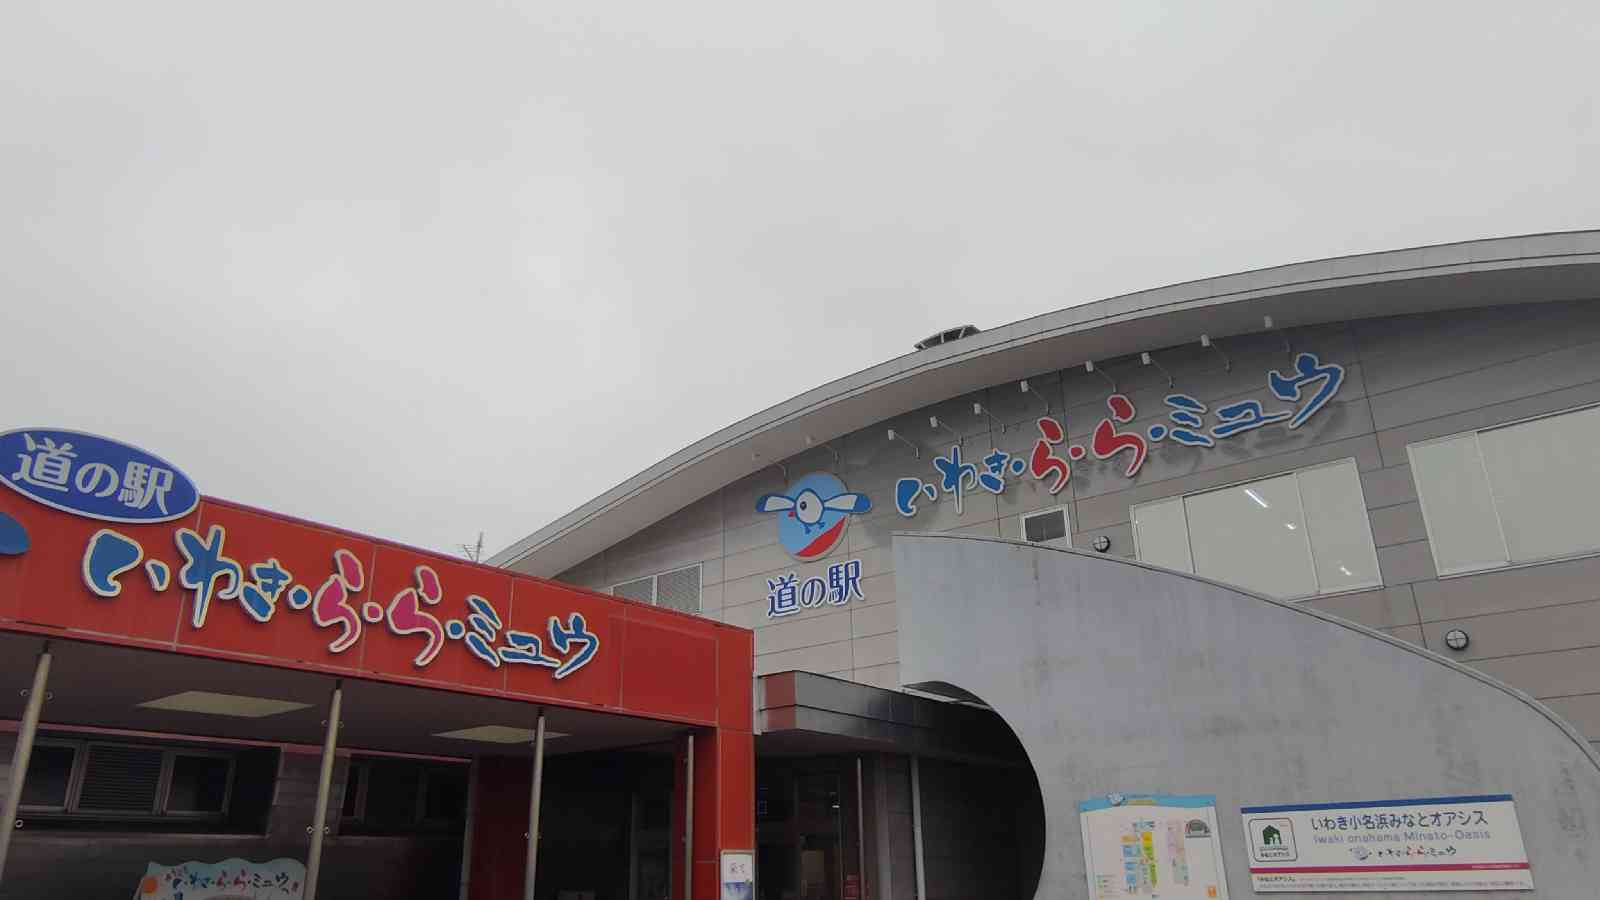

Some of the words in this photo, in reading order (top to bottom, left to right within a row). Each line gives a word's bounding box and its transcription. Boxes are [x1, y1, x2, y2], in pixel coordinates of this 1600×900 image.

[12, 433, 174, 516] 道の駅
[766, 558, 864, 618] 道の駅
[1311, 810, 1489, 831] いわき小名浜みなとオアシス
